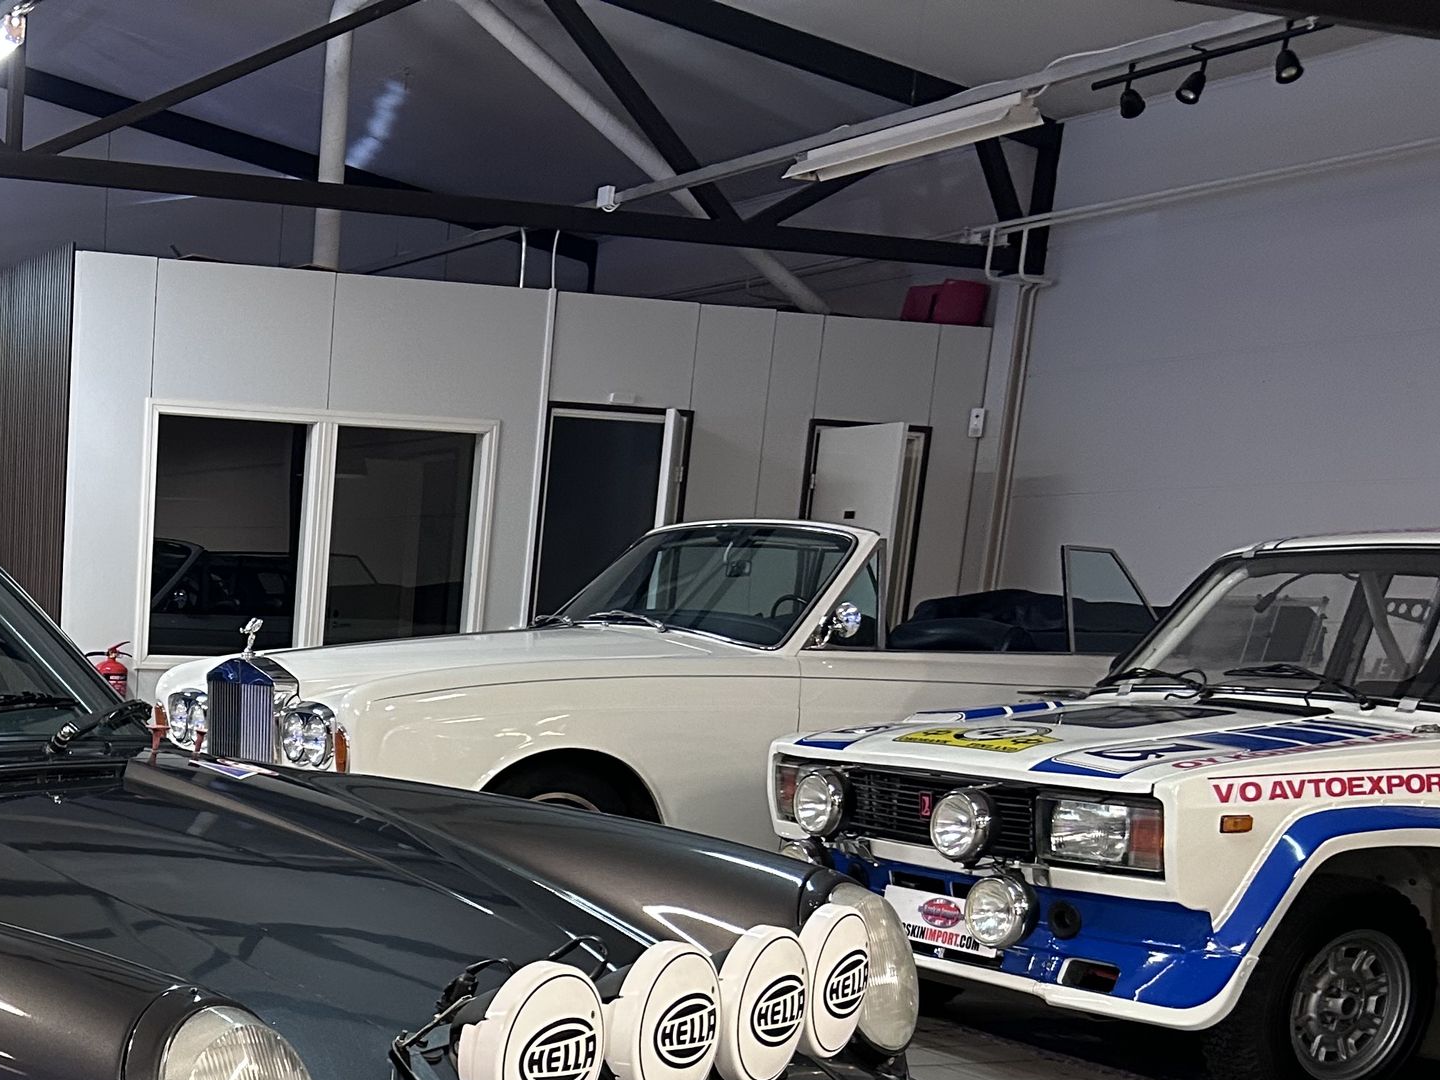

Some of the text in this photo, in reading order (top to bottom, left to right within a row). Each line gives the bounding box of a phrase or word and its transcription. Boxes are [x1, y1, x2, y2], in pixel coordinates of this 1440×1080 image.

[1171, 757, 1218, 770] OY
[1268, 773, 1440, 801] AVTOEXPOR
[902, 922, 980, 952] SKINIMPORT.COM
[828, 967, 868, 1002] HELLA
[758, 993, 805, 1029] HELLA
[661, 1012, 716, 1047] HELLA
[528, 1034, 597, 1074] HELLA
